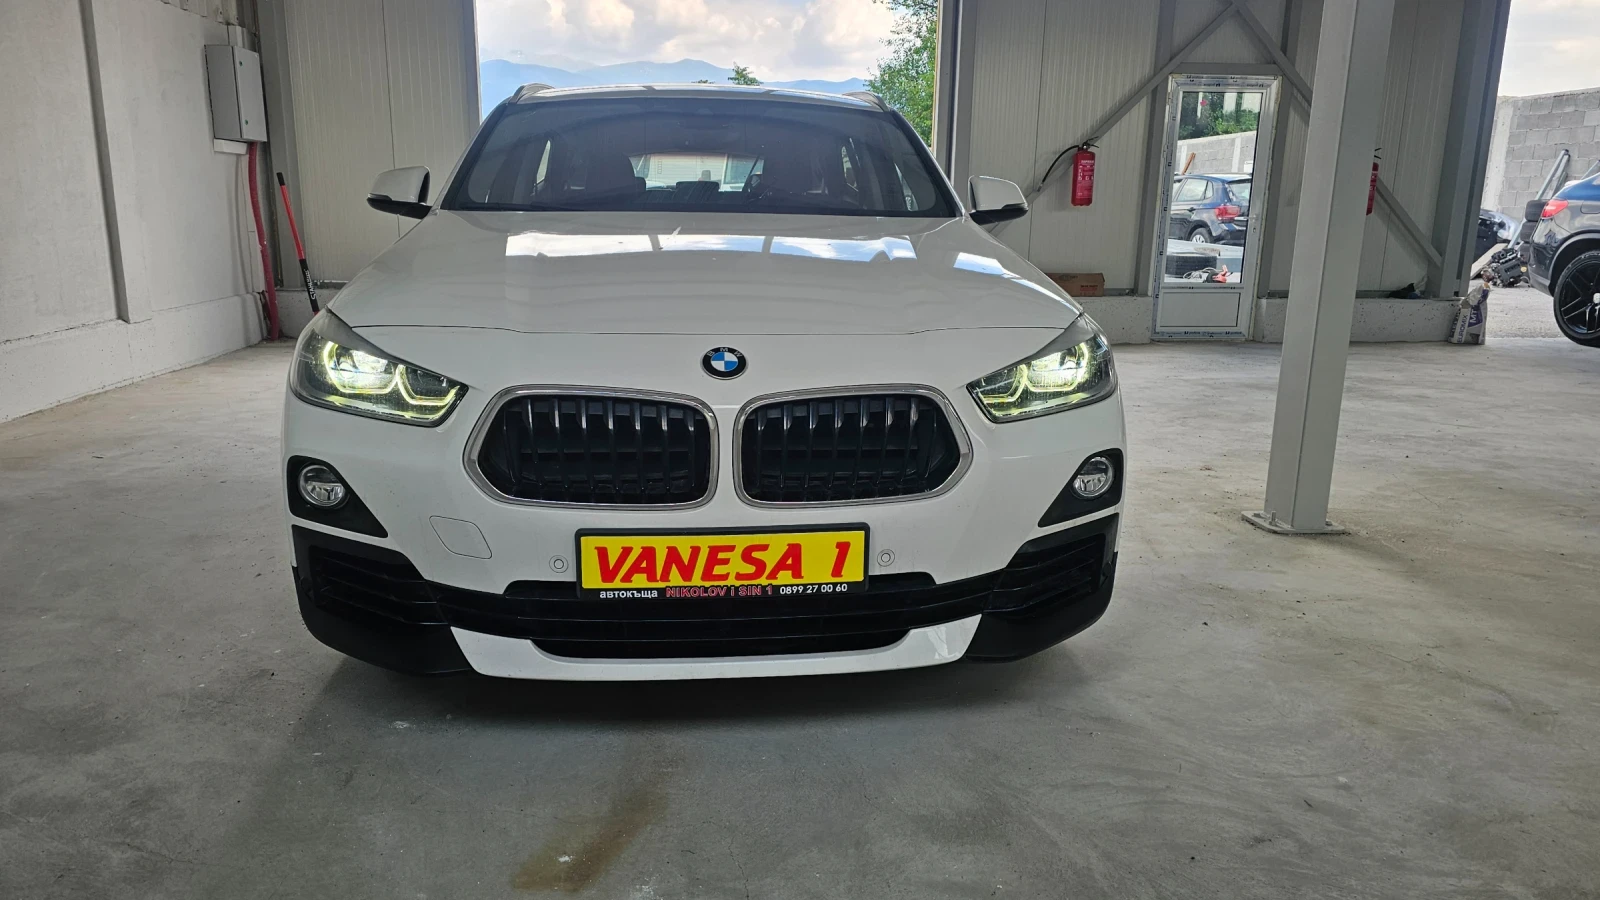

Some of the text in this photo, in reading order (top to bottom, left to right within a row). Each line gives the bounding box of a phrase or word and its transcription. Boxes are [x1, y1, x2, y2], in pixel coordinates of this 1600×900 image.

[707, 347, 743, 357] BMW
[594, 541, 851, 583] VANESA 1
[599, 590, 658, 599] автокъща
[665, 586, 728, 598] NIKOLOV
[738, 585, 762, 597] SIN
[765, 584, 773, 596] 1
[779, 586, 804, 595] 0899
[806, 585, 819, 594] 27
[820, 584, 833, 593] 00
[835, 583, 848, 592] 60
